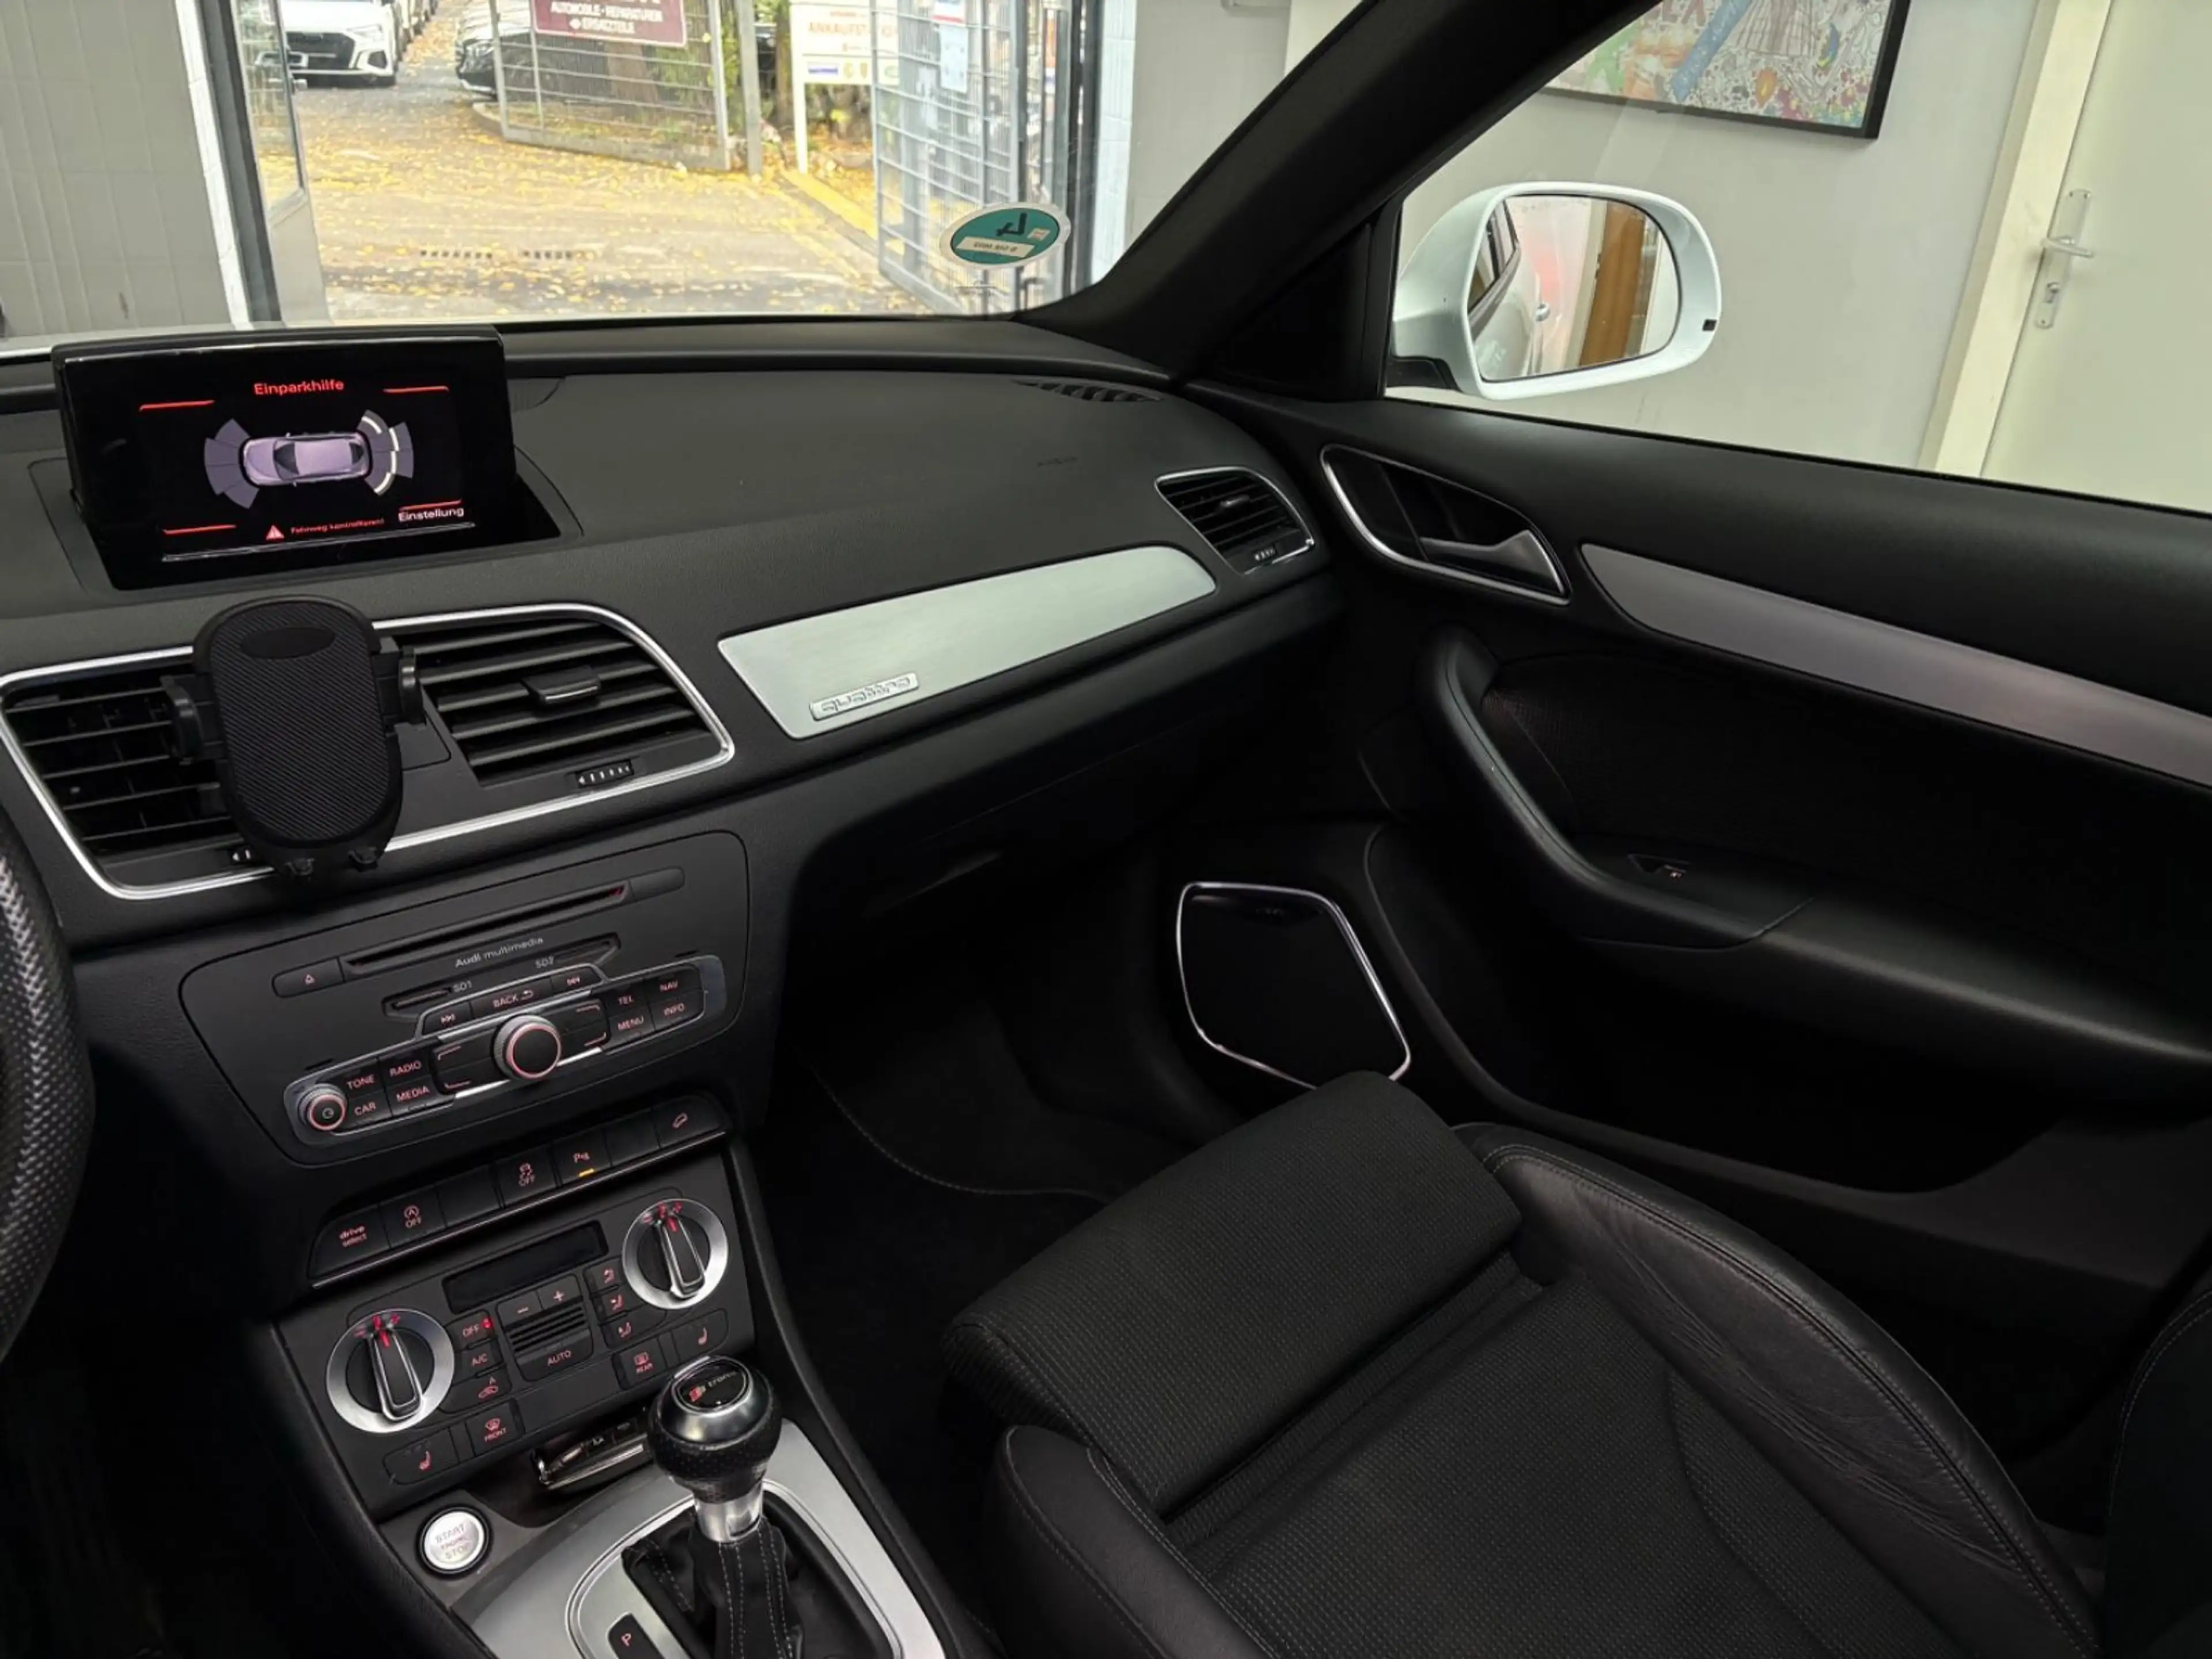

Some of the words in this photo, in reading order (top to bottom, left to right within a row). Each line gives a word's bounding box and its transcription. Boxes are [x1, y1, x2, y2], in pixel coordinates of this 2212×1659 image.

[253, 378, 344, 396] Einparkhilfe
[398, 506, 464, 522] Einstellung
[455, 951, 482, 968] Audi
[483, 937, 544, 959] multimedia
[493, 994, 519, 1008] BACK
[618, 1016, 644, 1031] MENU
[389, 1059, 422, 1077] RADIO
[347, 1074, 375, 1090] TONE
[396, 1085, 430, 1102] MEDIA
[354, 1101, 376, 1116] CAR
[463, 1324, 479, 1338] OFF
[472, 1353, 488, 1366] A/C
[547, 1350, 571, 1367] AUTO
[435, 1522, 464, 1544] START
[621, 1633, 631, 1647] P
